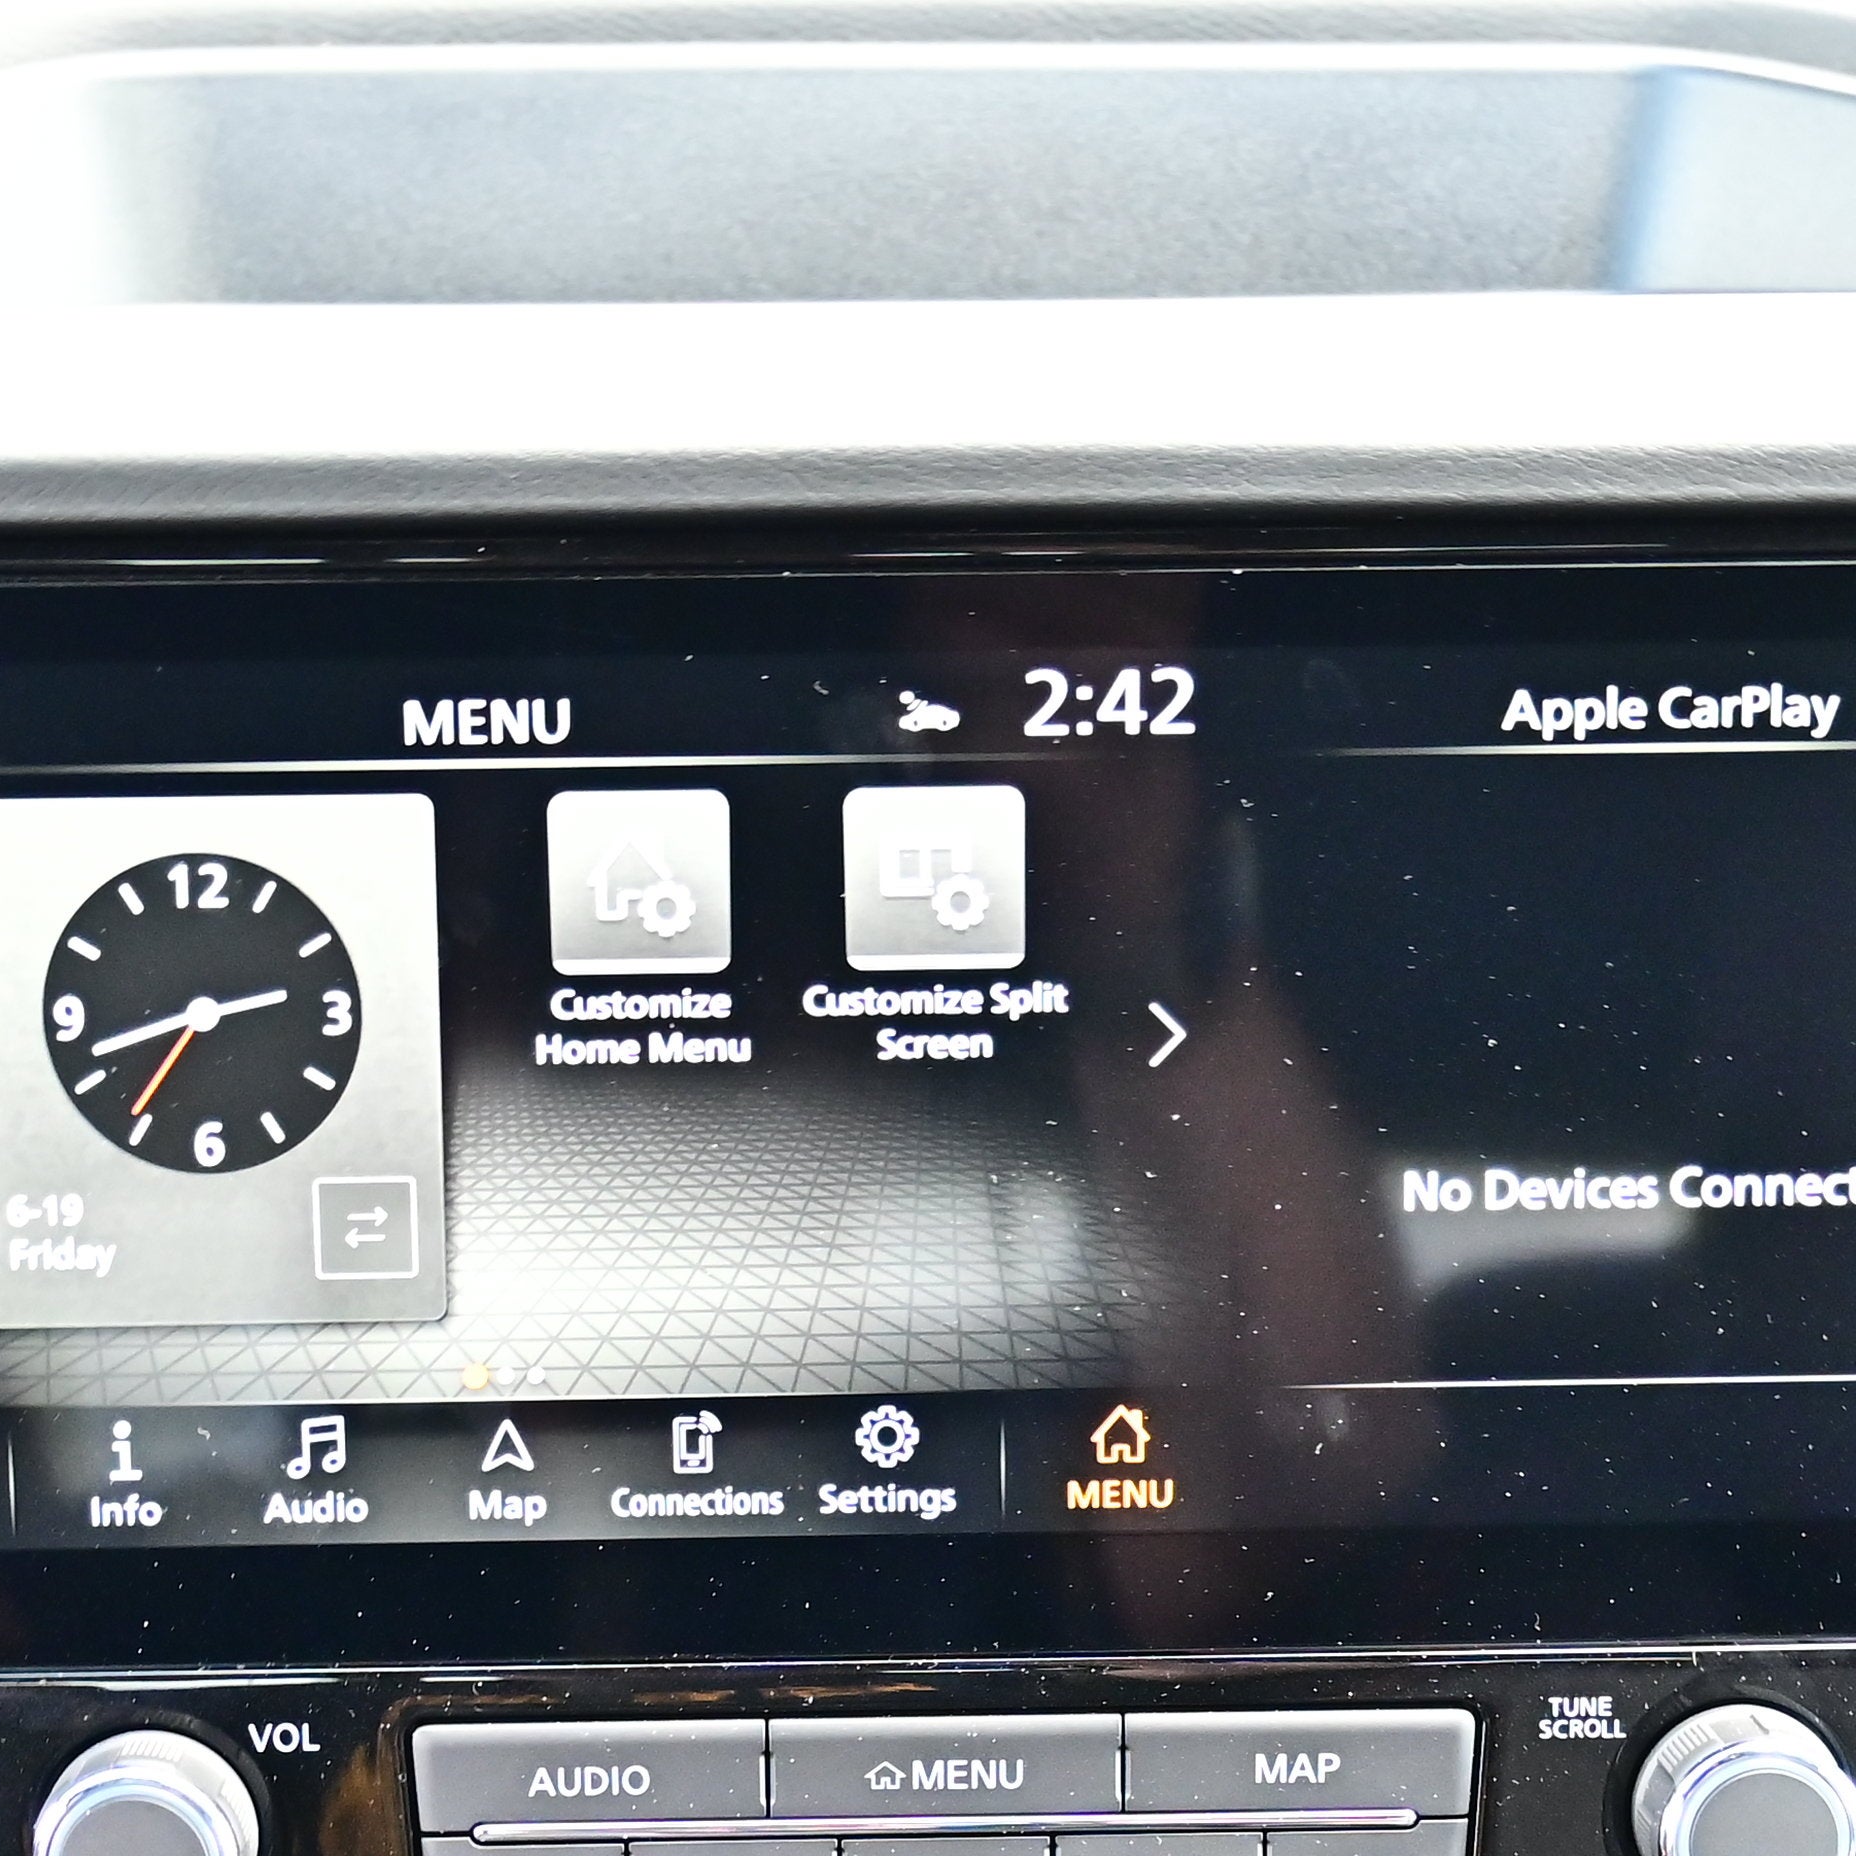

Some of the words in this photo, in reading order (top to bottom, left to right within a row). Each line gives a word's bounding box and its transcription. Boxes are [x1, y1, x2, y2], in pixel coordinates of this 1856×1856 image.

[1024, 666, 1195, 736] 2:42
[1501, 685, 1648, 741] Apple
[1659, 683, 1840, 738] CarPlay
[403, 698, 570, 745] MENU
[167, 861, 229, 908] 12
[53, 994, 85, 1041] 9
[322, 990, 352, 1036] 3
[550, 988, 732, 1020] Customize
[803, 984, 984, 1017] Customize
[990, 980, 1069, 1021] Split
[535, 1034, 641, 1065] Home
[649, 1032, 751, 1063] Menu
[877, 1028, 993, 1060] Screen
[194, 1121, 225, 1167] 6
[1404, 1170, 1473, 1212] No
[1484, 1167, 1661, 1211] Devices
[5, 1193, 84, 1227] 6-19
[9, 1236, 117, 1277] Friday
[90, 1493, 163, 1527] Info
[264, 1491, 368, 1523] Audio
[469, 1490, 547, 1526] Map
[611, 1486, 784, 1517] Connections
[819, 1484, 956, 1520] Settings
[1067, 1479, 1173, 1509] MENU
[1548, 1696, 1612, 1717] TUNE
[248, 1723, 320, 1752] VOL
[1539, 1718, 1626, 1739] SCROLL
[528, 1765, 650, 1797] AUDIO
[913, 1759, 1023, 1789] MENU
[1255, 1753, 1340, 1783] MAP
